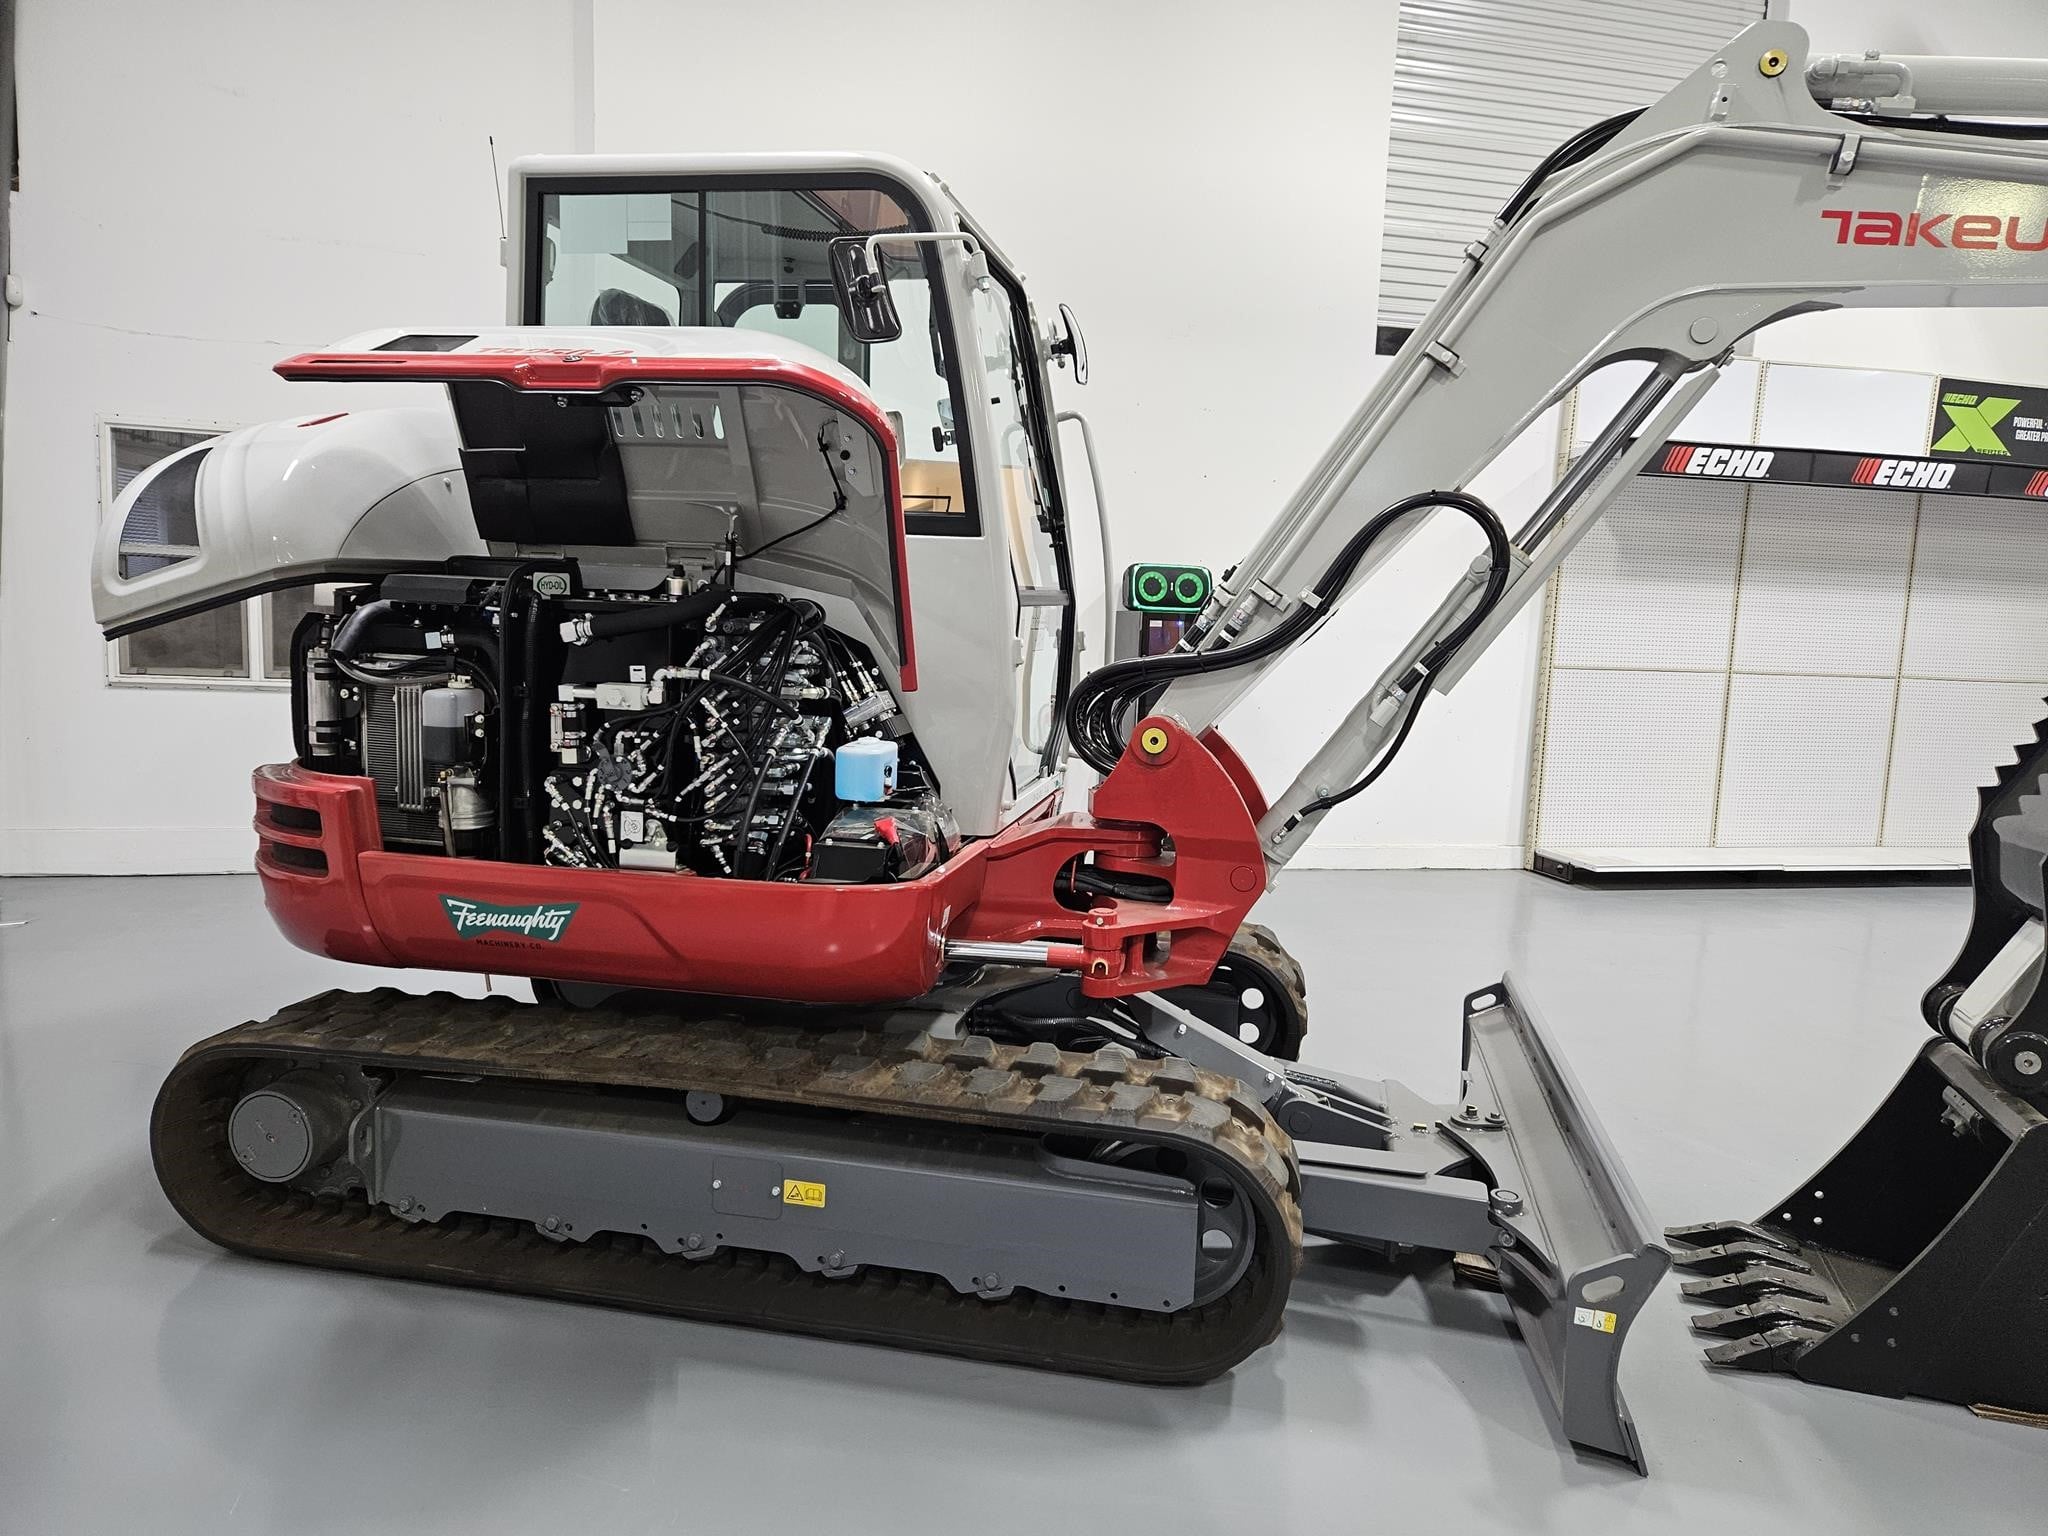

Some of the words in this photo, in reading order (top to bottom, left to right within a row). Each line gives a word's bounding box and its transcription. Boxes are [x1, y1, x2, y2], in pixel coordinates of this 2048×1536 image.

[1948, 393, 1978, 405] ECHO
[2012, 416, 2044, 429] POWERFUL
[2015, 430, 2041, 441] GREATER
[1685, 447, 1775, 478] ECHO
[1873, 459, 1957, 489] ECHO
[446, 898, 572, 941] Feenaughty
[475, 938, 526, 949] MACHINERY
